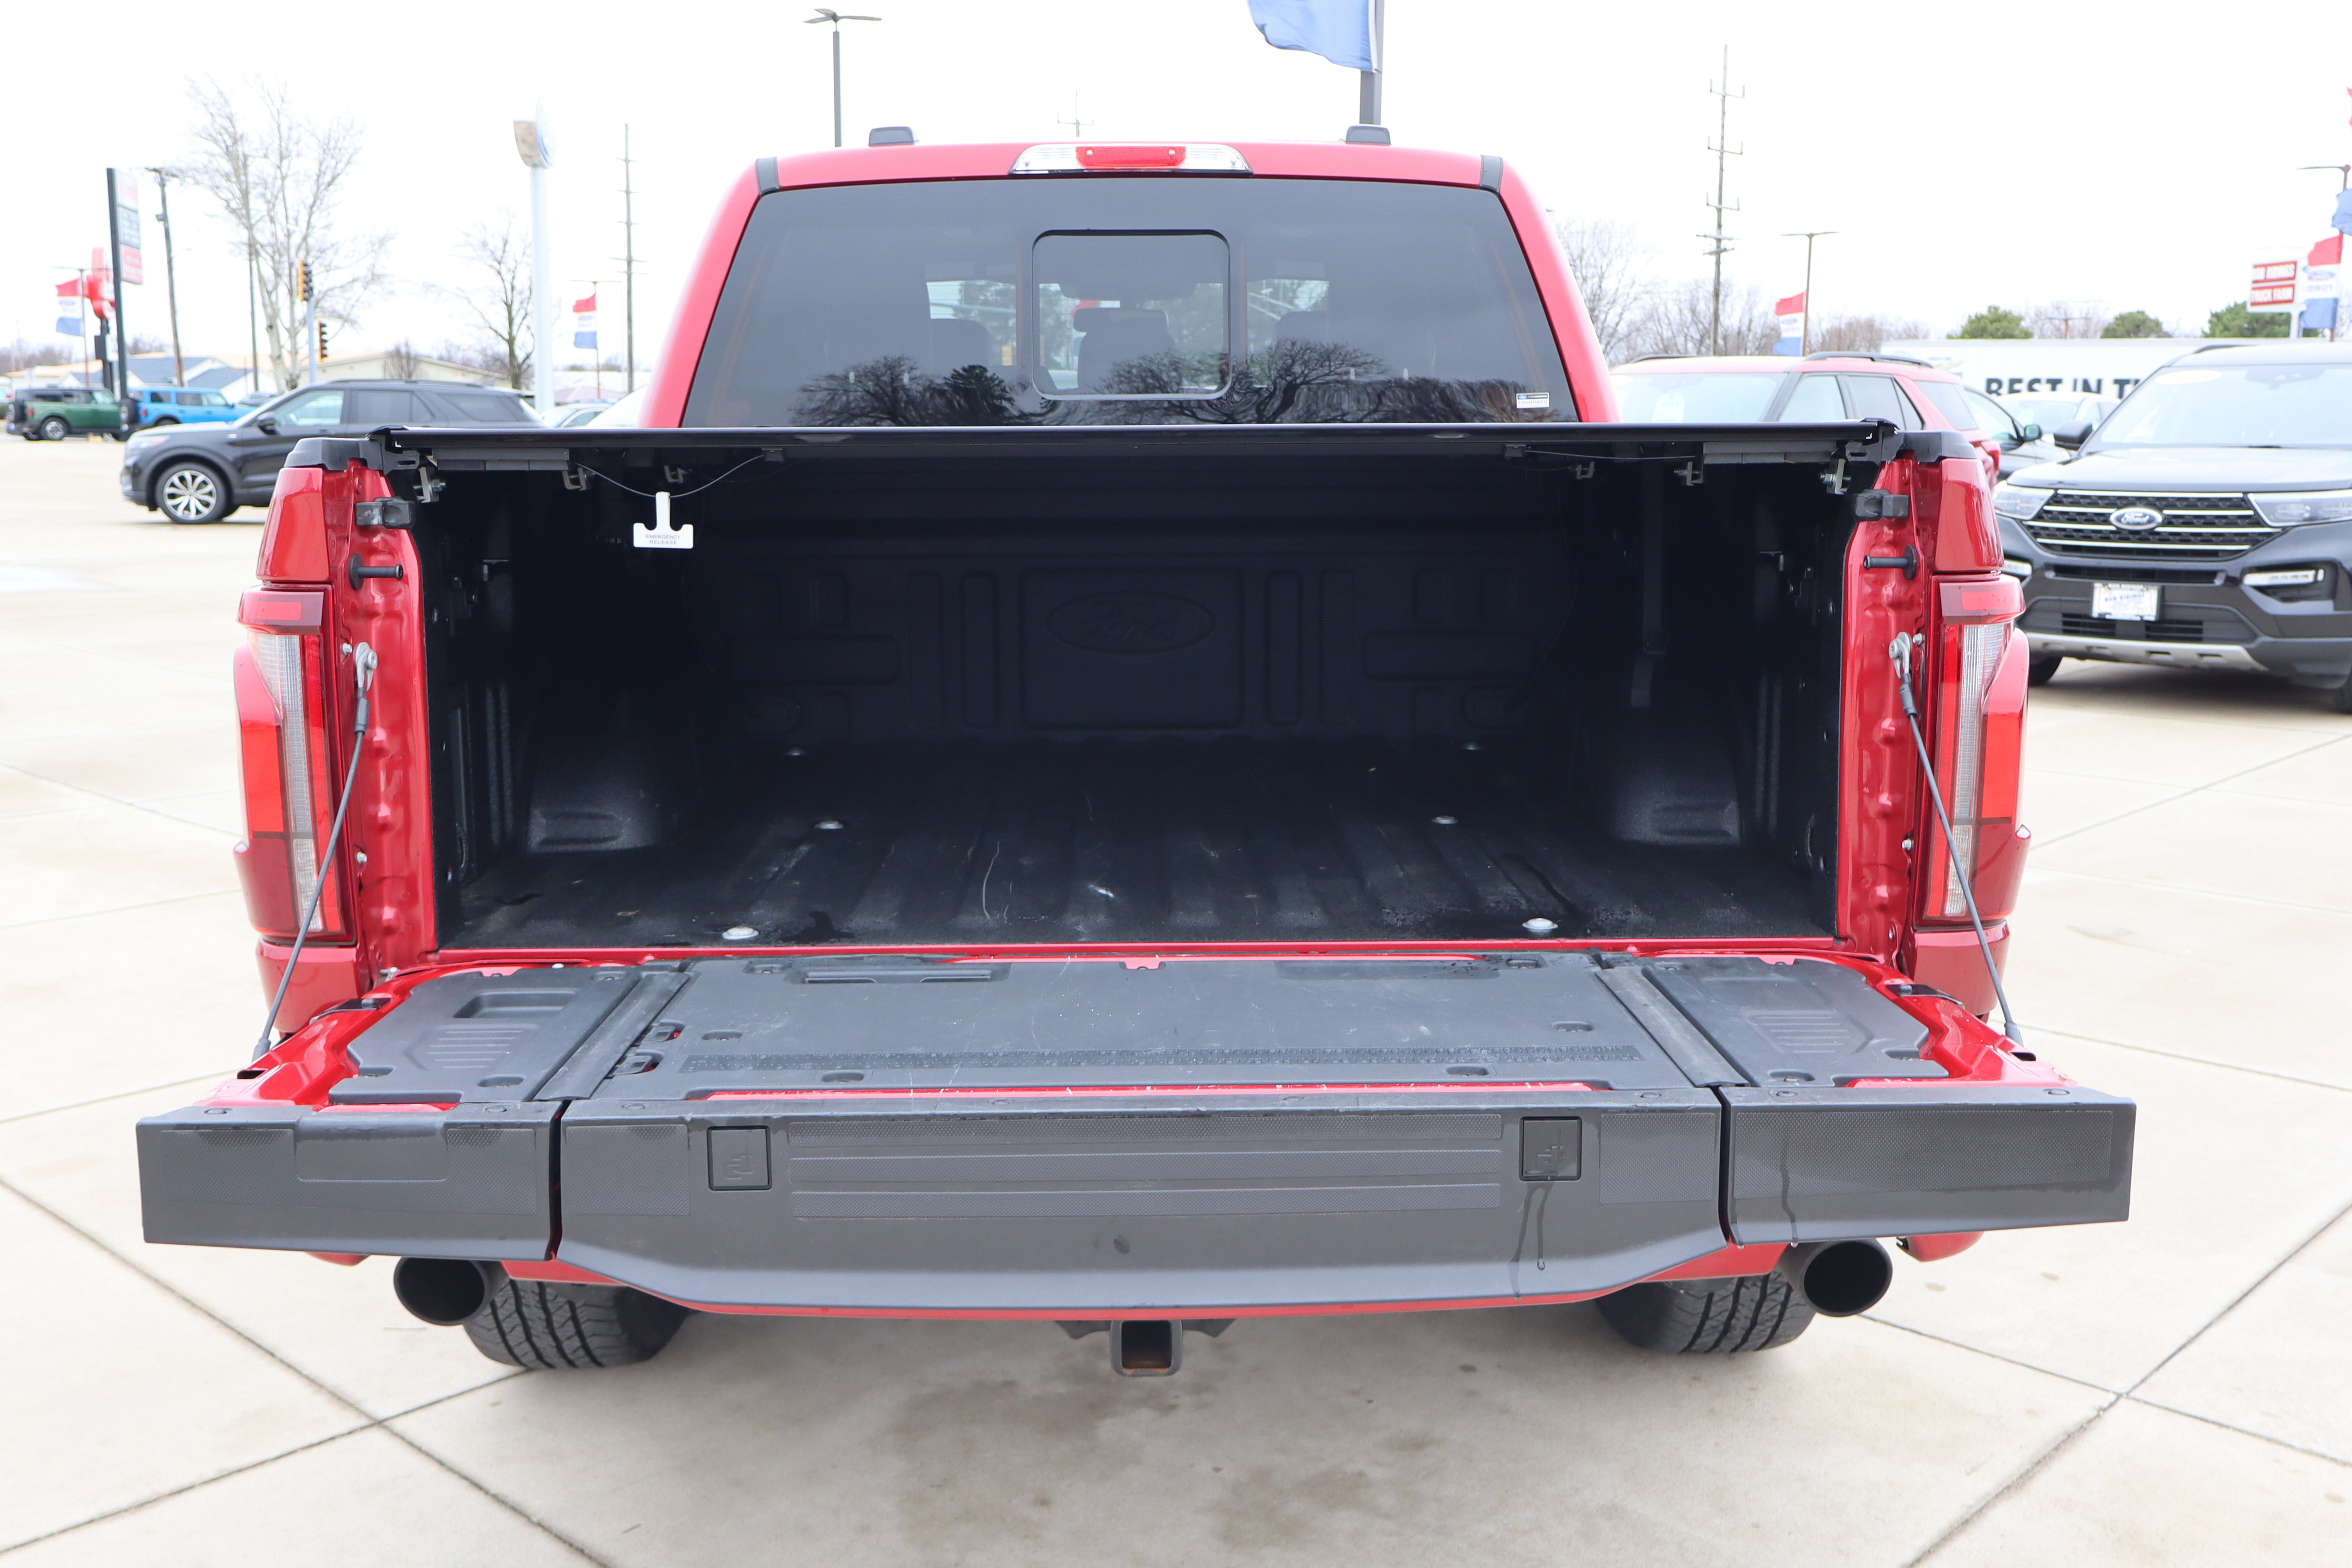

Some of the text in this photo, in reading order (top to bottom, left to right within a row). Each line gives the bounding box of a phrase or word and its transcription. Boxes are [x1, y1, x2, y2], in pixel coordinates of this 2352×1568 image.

[1986, 378, 2062, 396] BEST
[2073, 379, 2102, 395] IN
[2120, 512, 2149, 523] Ford
